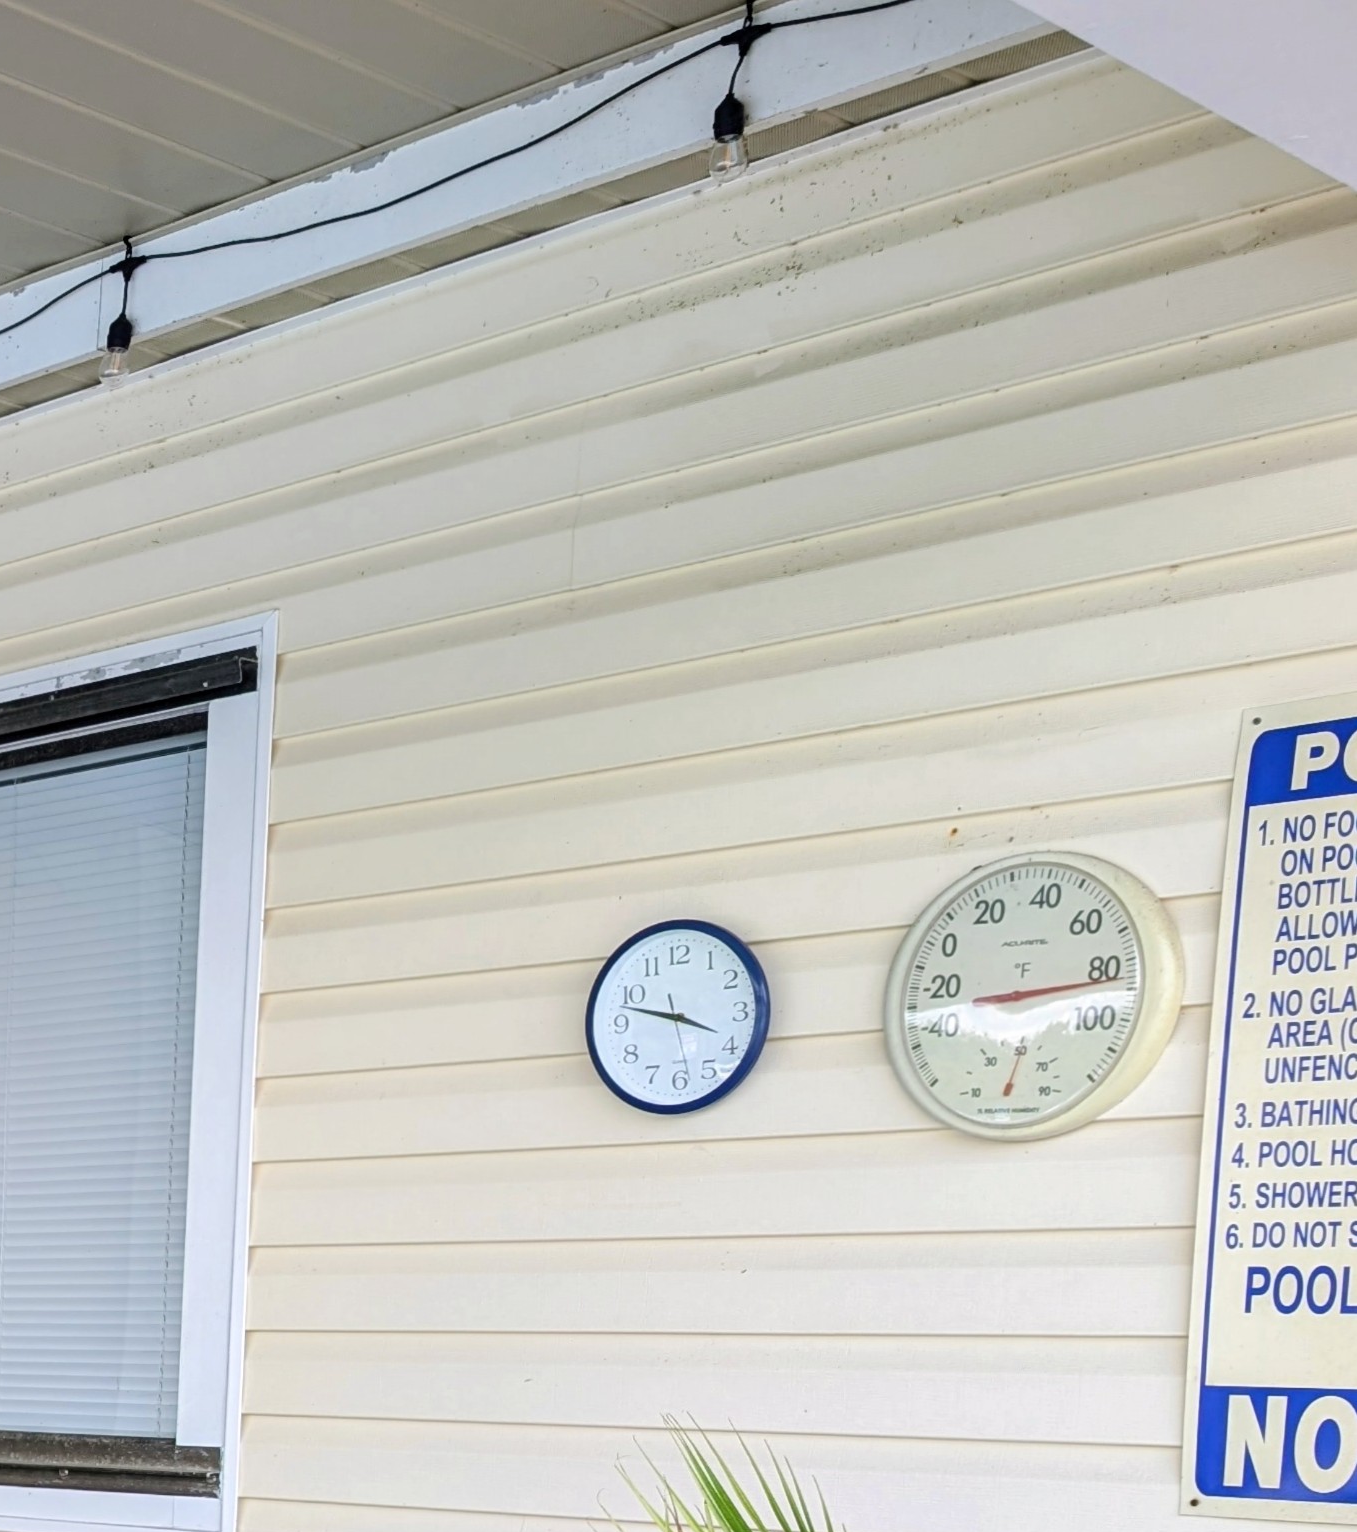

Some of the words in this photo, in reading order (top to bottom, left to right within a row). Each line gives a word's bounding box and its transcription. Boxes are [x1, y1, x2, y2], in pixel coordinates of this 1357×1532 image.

[1290, 730, 1357, 791] P
[1259, 819, 1274, 846] 1.
[1283, 814, 1316, 844] NO
[1323, 809, 1357, 839] FO
[1281, 847, 1314, 877] ON
[1322, 843, 1357, 873] PO
[1029, 883, 1062, 909] 40
[1277, 877, 1357, 910] BOTTL
[973, 899, 1005, 925] 20
[1069, 908, 1102, 936] 60
[669, 945, 691, 966] 12
[941, 933, 957, 957] 0
[644, 956, 660, 977] 11
[707, 951, 714, 970] 1
[1087, 955, 1121, 981] 80
[1272, 945, 1336, 975] POOL
[723, 970, 738, 990] 2
[923, 974, 961, 999] -20
[623, 984, 646, 1005] 10
[1242, 992, 1261, 1019] 2.
[1269, 989, 1303, 1017] NO
[1310, 985, 1357, 1015] GLA
[613, 1014, 629, 1034] 9
[732, 1001, 749, 1022] 3
[1075, 1005, 1116, 1031] 100
[921, 1012, 959, 1038] -40
[1267, 1019, 1333, 1049] AREA
[623, 1044, 639, 1064] 8
[721, 1035, 738, 1055] 4
[1014, 1045, 1027, 1056] 50
[645, 1065, 661, 1084] 7
[701, 1059, 717, 1080] 5
[984, 1056, 997, 1067] 30
[1036, 1061, 1048, 1072] 70
[1264, 1053, 1357, 1084] UNFENC
[672, 1070, 689, 1090] 6
[971, 1088, 981, 1098] 10
[1038, 1086, 1051, 1096] 90
[1234, 1103, 1252, 1129] 3.
[1231, 1142, 1249, 1168] 4.
[1258, 1140, 1322, 1168] POOL
[1228, 1184, 1246, 1209] 5.
[1255, 1181, 1357, 1209] SHOWER
[1225, 1224, 1244, 1250] 6.
[1252, 1221, 1286, 1248] DO
[1293, 1221, 1342, 1248] NOT
[1244, 1265, 1357, 1315] POOL
[1223, 1394, 1357, 1494] NO
